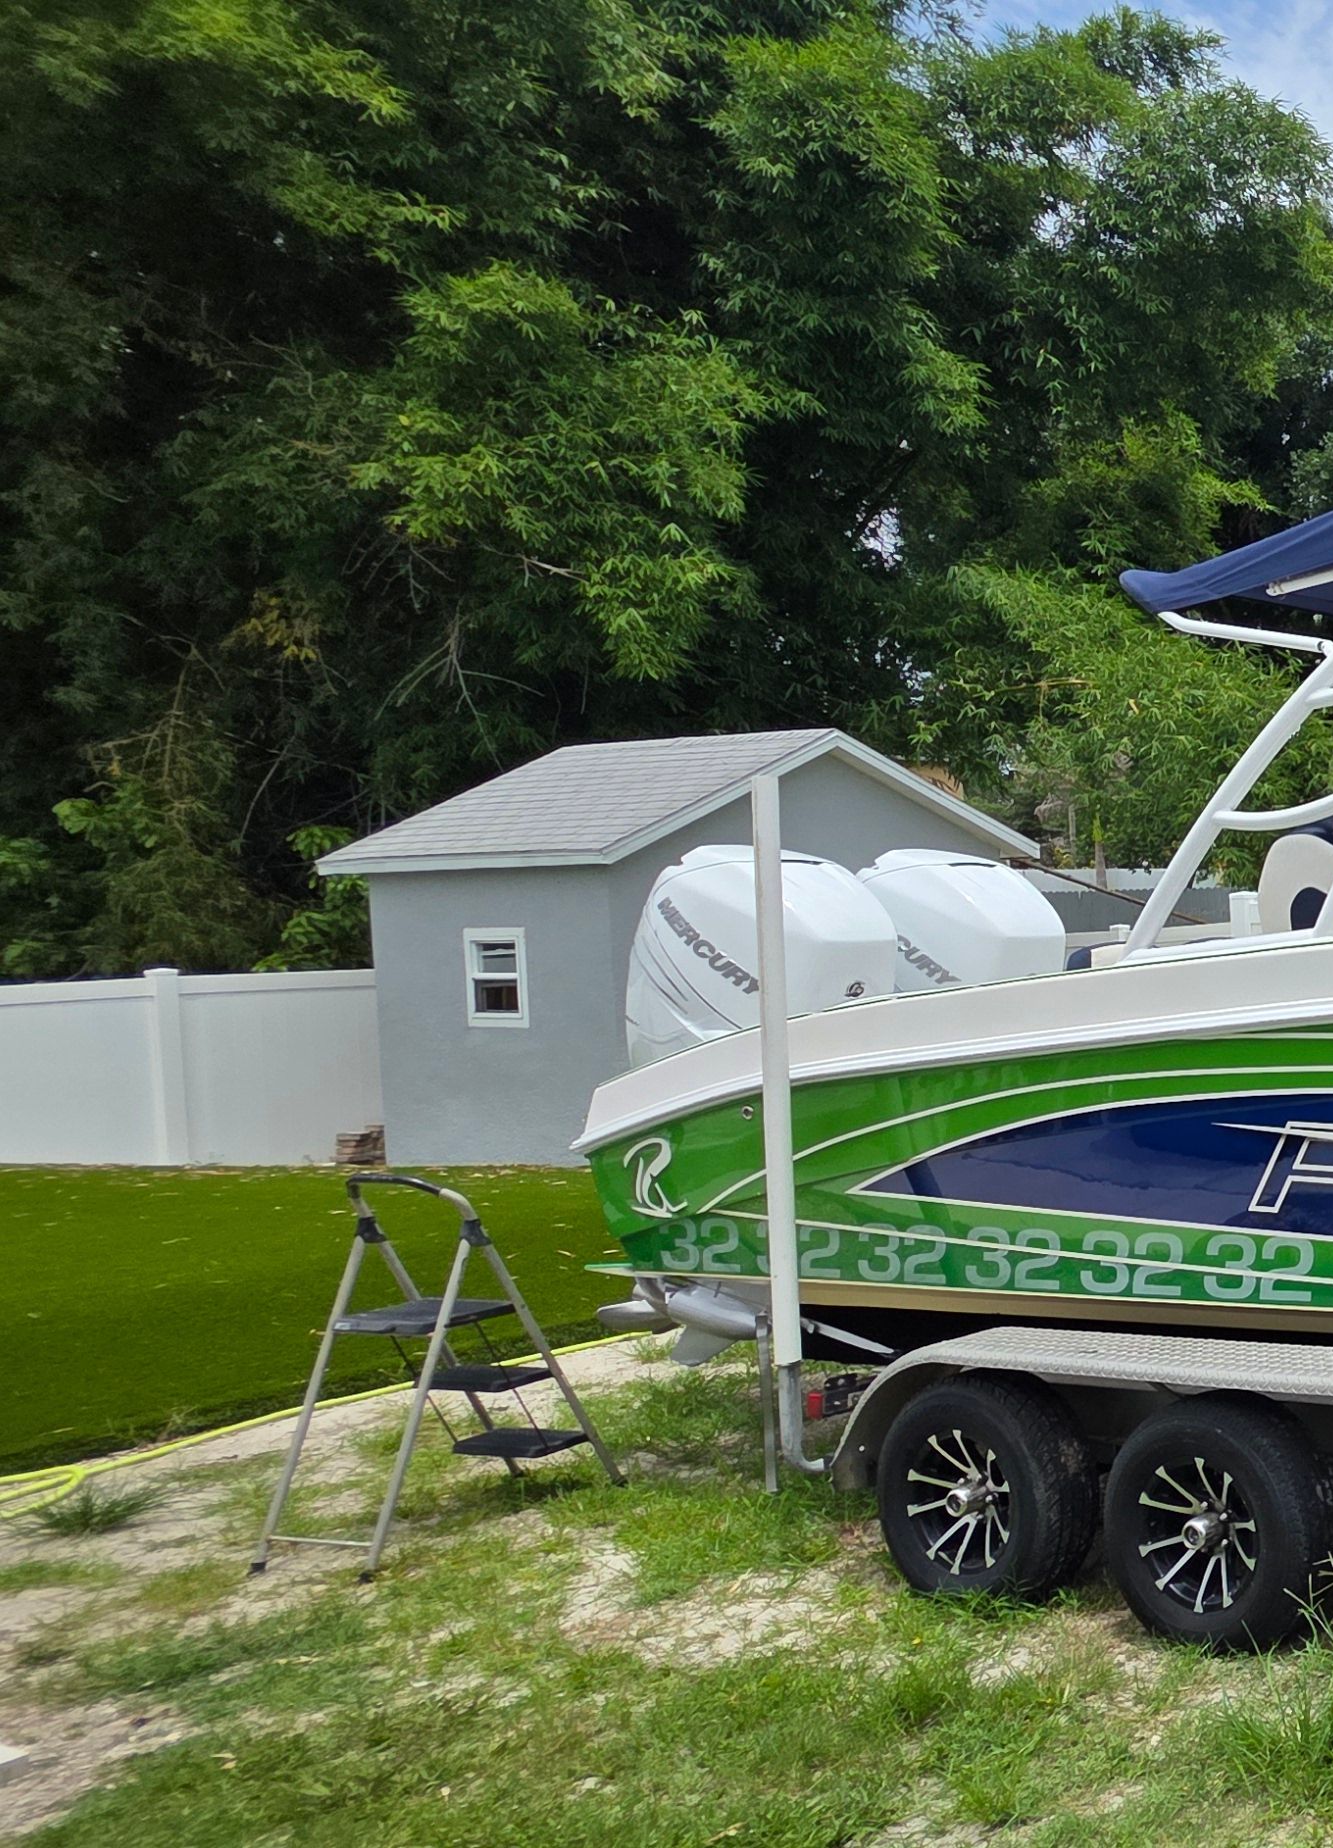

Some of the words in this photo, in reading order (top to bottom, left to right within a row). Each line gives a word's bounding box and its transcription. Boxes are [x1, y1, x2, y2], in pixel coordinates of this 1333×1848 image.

[657, 896, 760, 995] MERCURY
[897, 934, 962, 984] CURY
[658, 1217, 741, 1273] 32
[857, 1223, 947, 1286] 32
[965, 1226, 1061, 1291] 32
[1079, 1230, 1184, 1297] 32
[1202, 1233, 1315, 1303] 32
